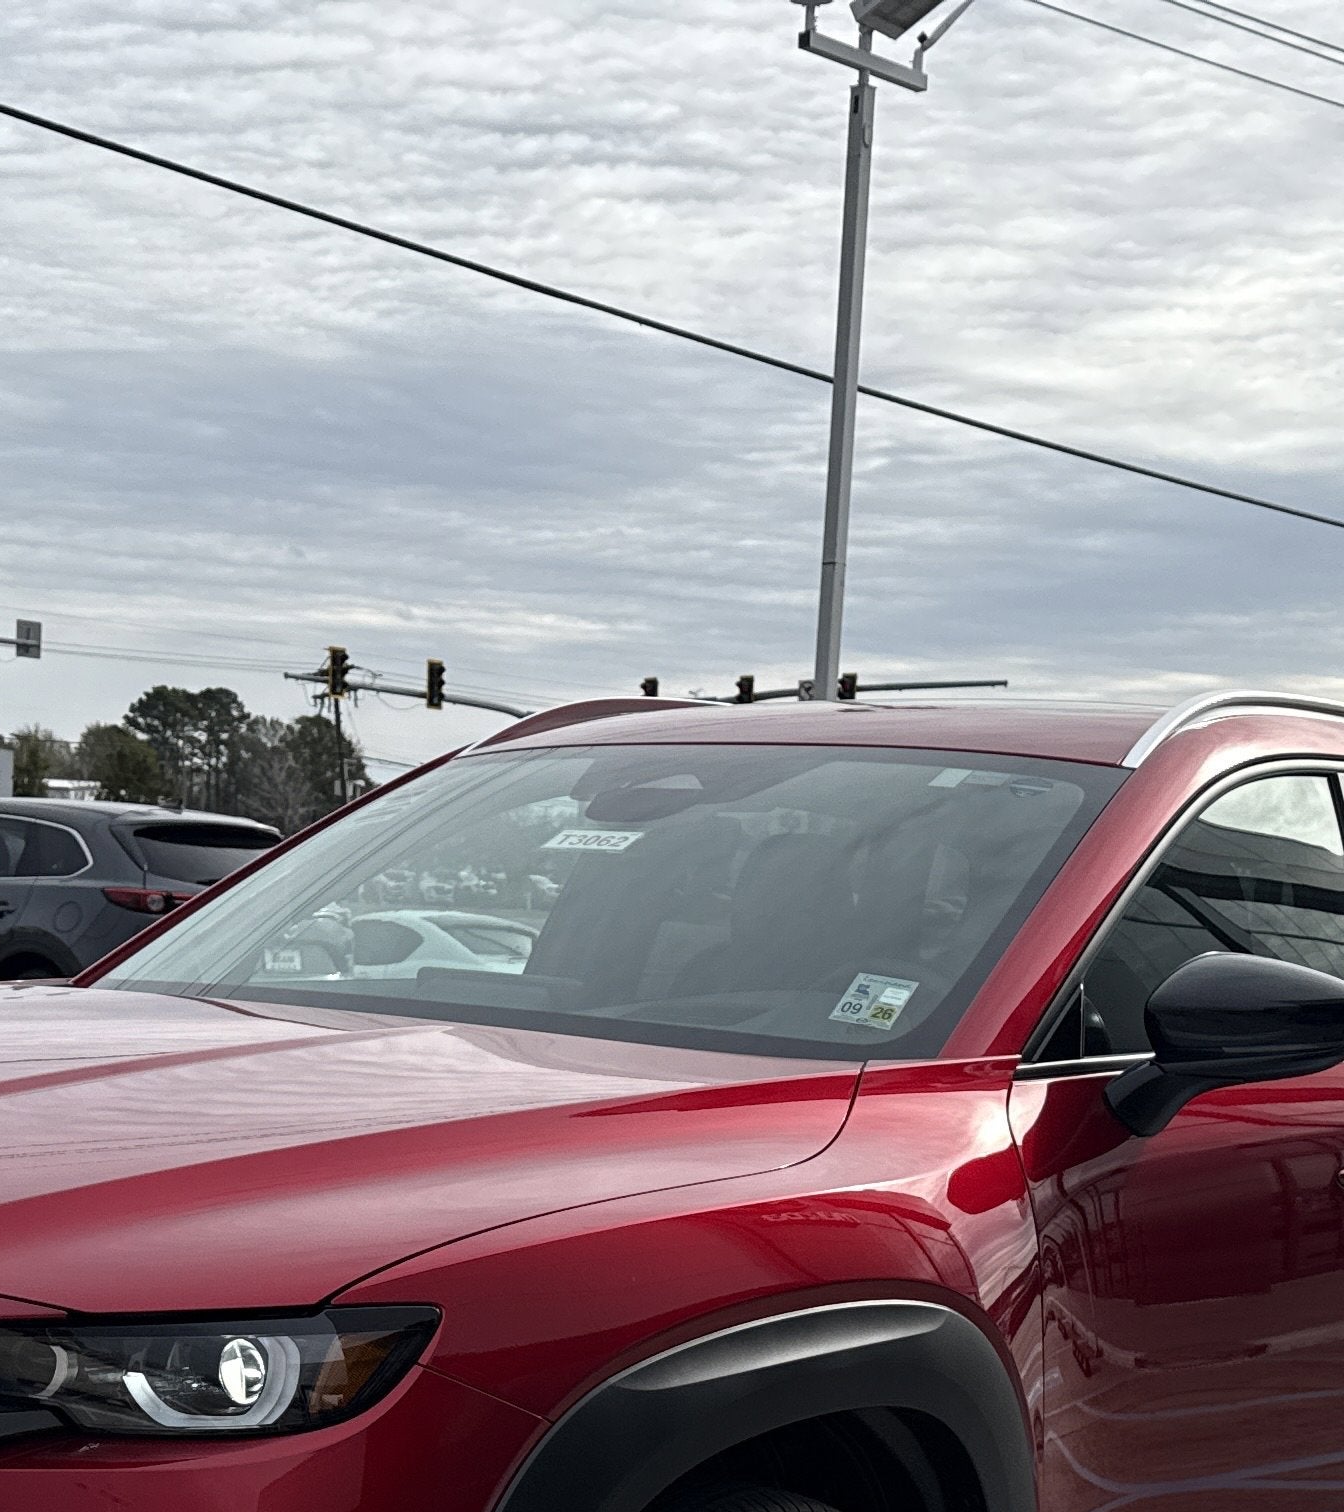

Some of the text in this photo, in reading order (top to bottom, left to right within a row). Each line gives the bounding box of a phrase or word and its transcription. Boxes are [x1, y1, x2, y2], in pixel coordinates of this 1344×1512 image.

[557, 834, 630, 847] T3062
[840, 1001, 894, 1020] 09 26
